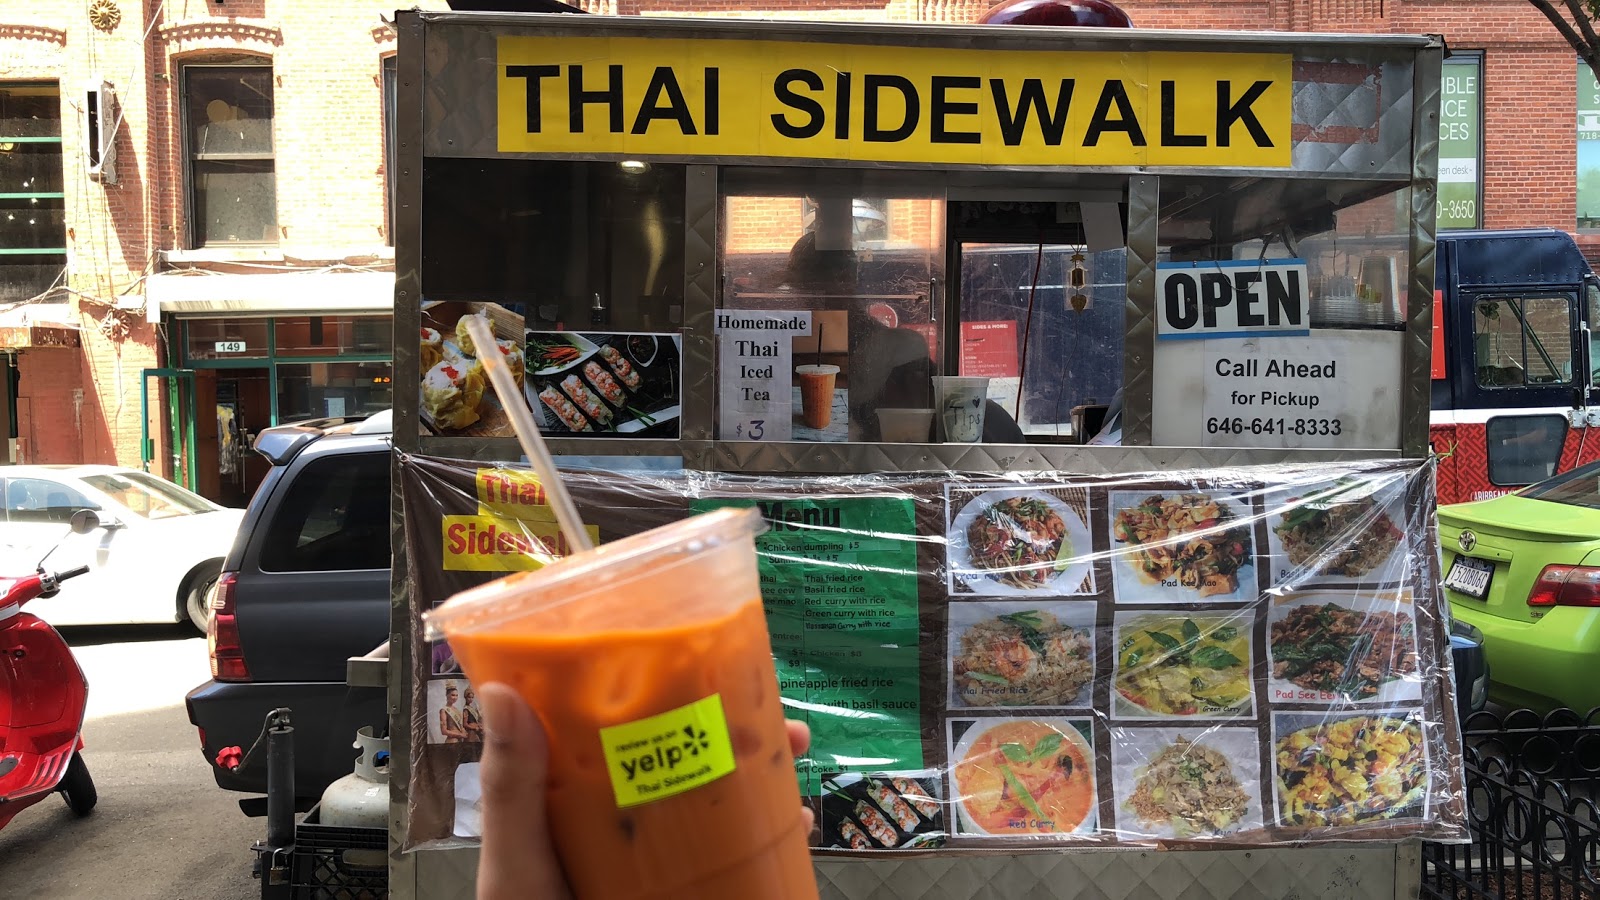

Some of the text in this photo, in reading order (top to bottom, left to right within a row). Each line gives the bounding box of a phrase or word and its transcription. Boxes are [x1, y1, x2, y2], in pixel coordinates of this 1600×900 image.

[1441, 76, 1475, 95] IBLE
[506, 64, 1275, 148] THAI SIDEWALK
[1441, 100, 1467, 117] ICE
[1439, 123, 1469, 140] CES
[1580, 131, 1600, 140] 718-
[1436, 200, 1475, 219] 0-3650
[1164, 270, 1302, 330] OPEN
[717, 314, 807, 331] Homemade
[220, 342, 241, 352] 149
[735, 340, 779, 357] Thai
[740, 365, 774, 379] Iced
[1215, 358, 1336, 379] Call Ahead
[741, 387, 771, 401] Tea
[1231, 391, 1320, 410] for Pickup
[949, 405, 981, 432] Tips
[1206, 417, 1342, 436] 646-641-8333
[756, 501, 840, 532] Menu
[447, 522, 572, 556] Sidewal
[767, 543, 802, 552] Chicken
[804, 543, 844, 553] dumpling
[804, 574, 863, 583] Thai fried rice
[1161, 579, 1178, 587] Pad
[804, 586, 825, 594] Basil
[827, 585, 847, 593] fried
[804, 598, 822, 606] Red
[825, 599, 847, 607] curry
[849, 597, 867, 605] with
[805, 609, 895, 619] Green curry with rice
[780, 677, 894, 690] pineapple fried rice
[1275, 690, 1294, 699] Pad
[1298, 691, 1316, 699] See
[852, 699, 879, 709] basil
[882, 701, 917, 709] sauce
[620, 745, 683, 782] yelp
[811, 765, 834, 773] Coke
[663, 764, 713, 787] Sidewalk
